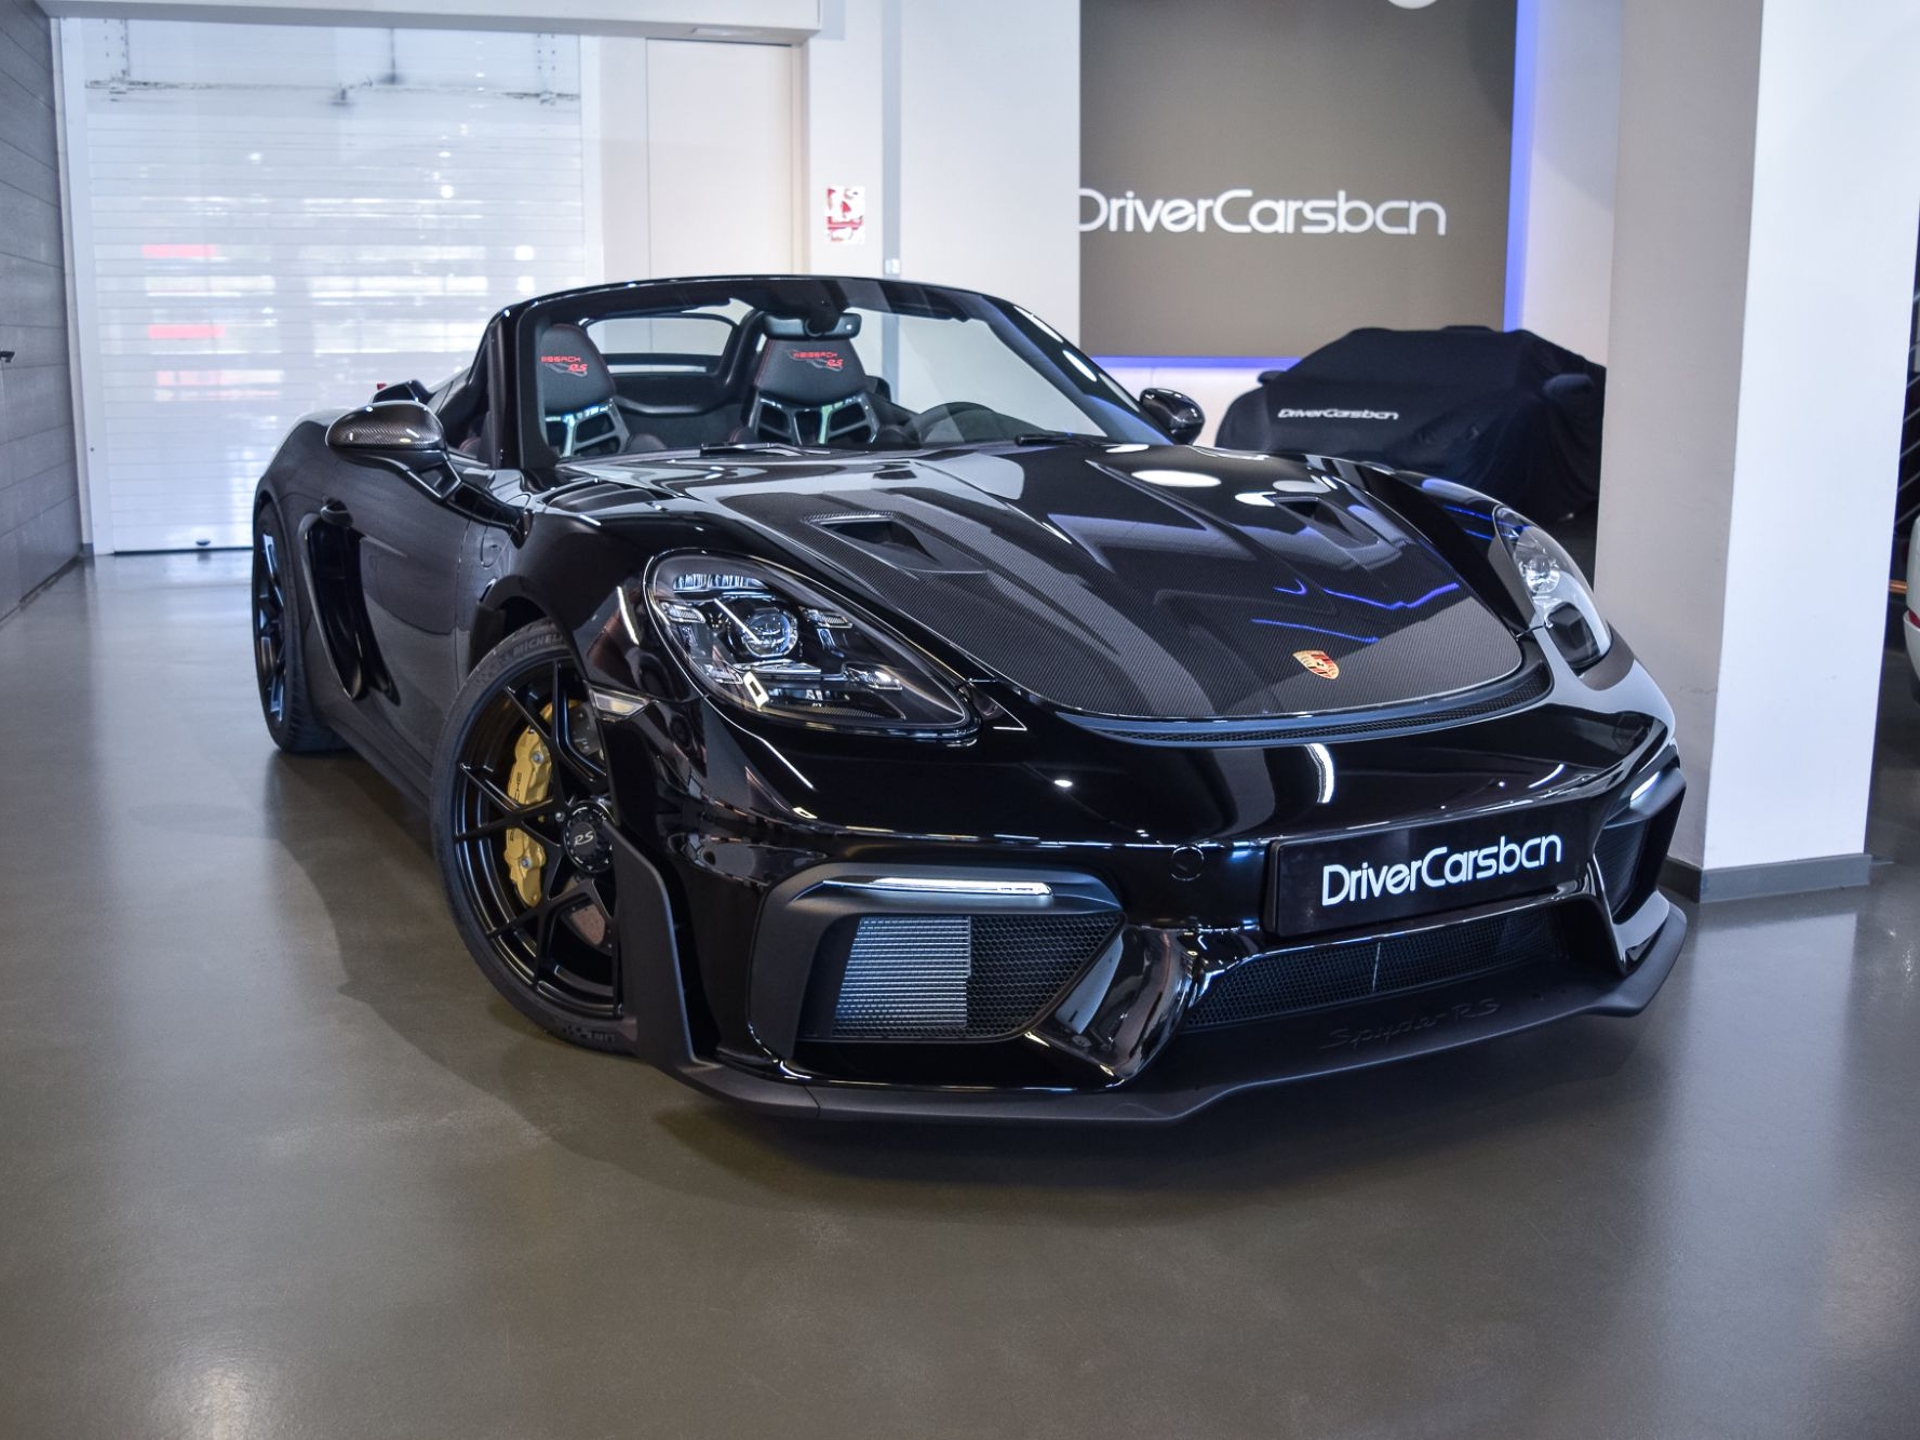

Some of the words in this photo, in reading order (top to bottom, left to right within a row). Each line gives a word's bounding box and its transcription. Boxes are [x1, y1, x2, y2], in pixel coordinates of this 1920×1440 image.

[1080, 188, 1446, 235] DriverCarsbcn
[1277, 408, 1399, 420] DriverCarsbcn
[574, 830, 595, 847] RS
[1322, 834, 1562, 906] DriverCarsbcn
[1452, 997, 1500, 1020] RS
